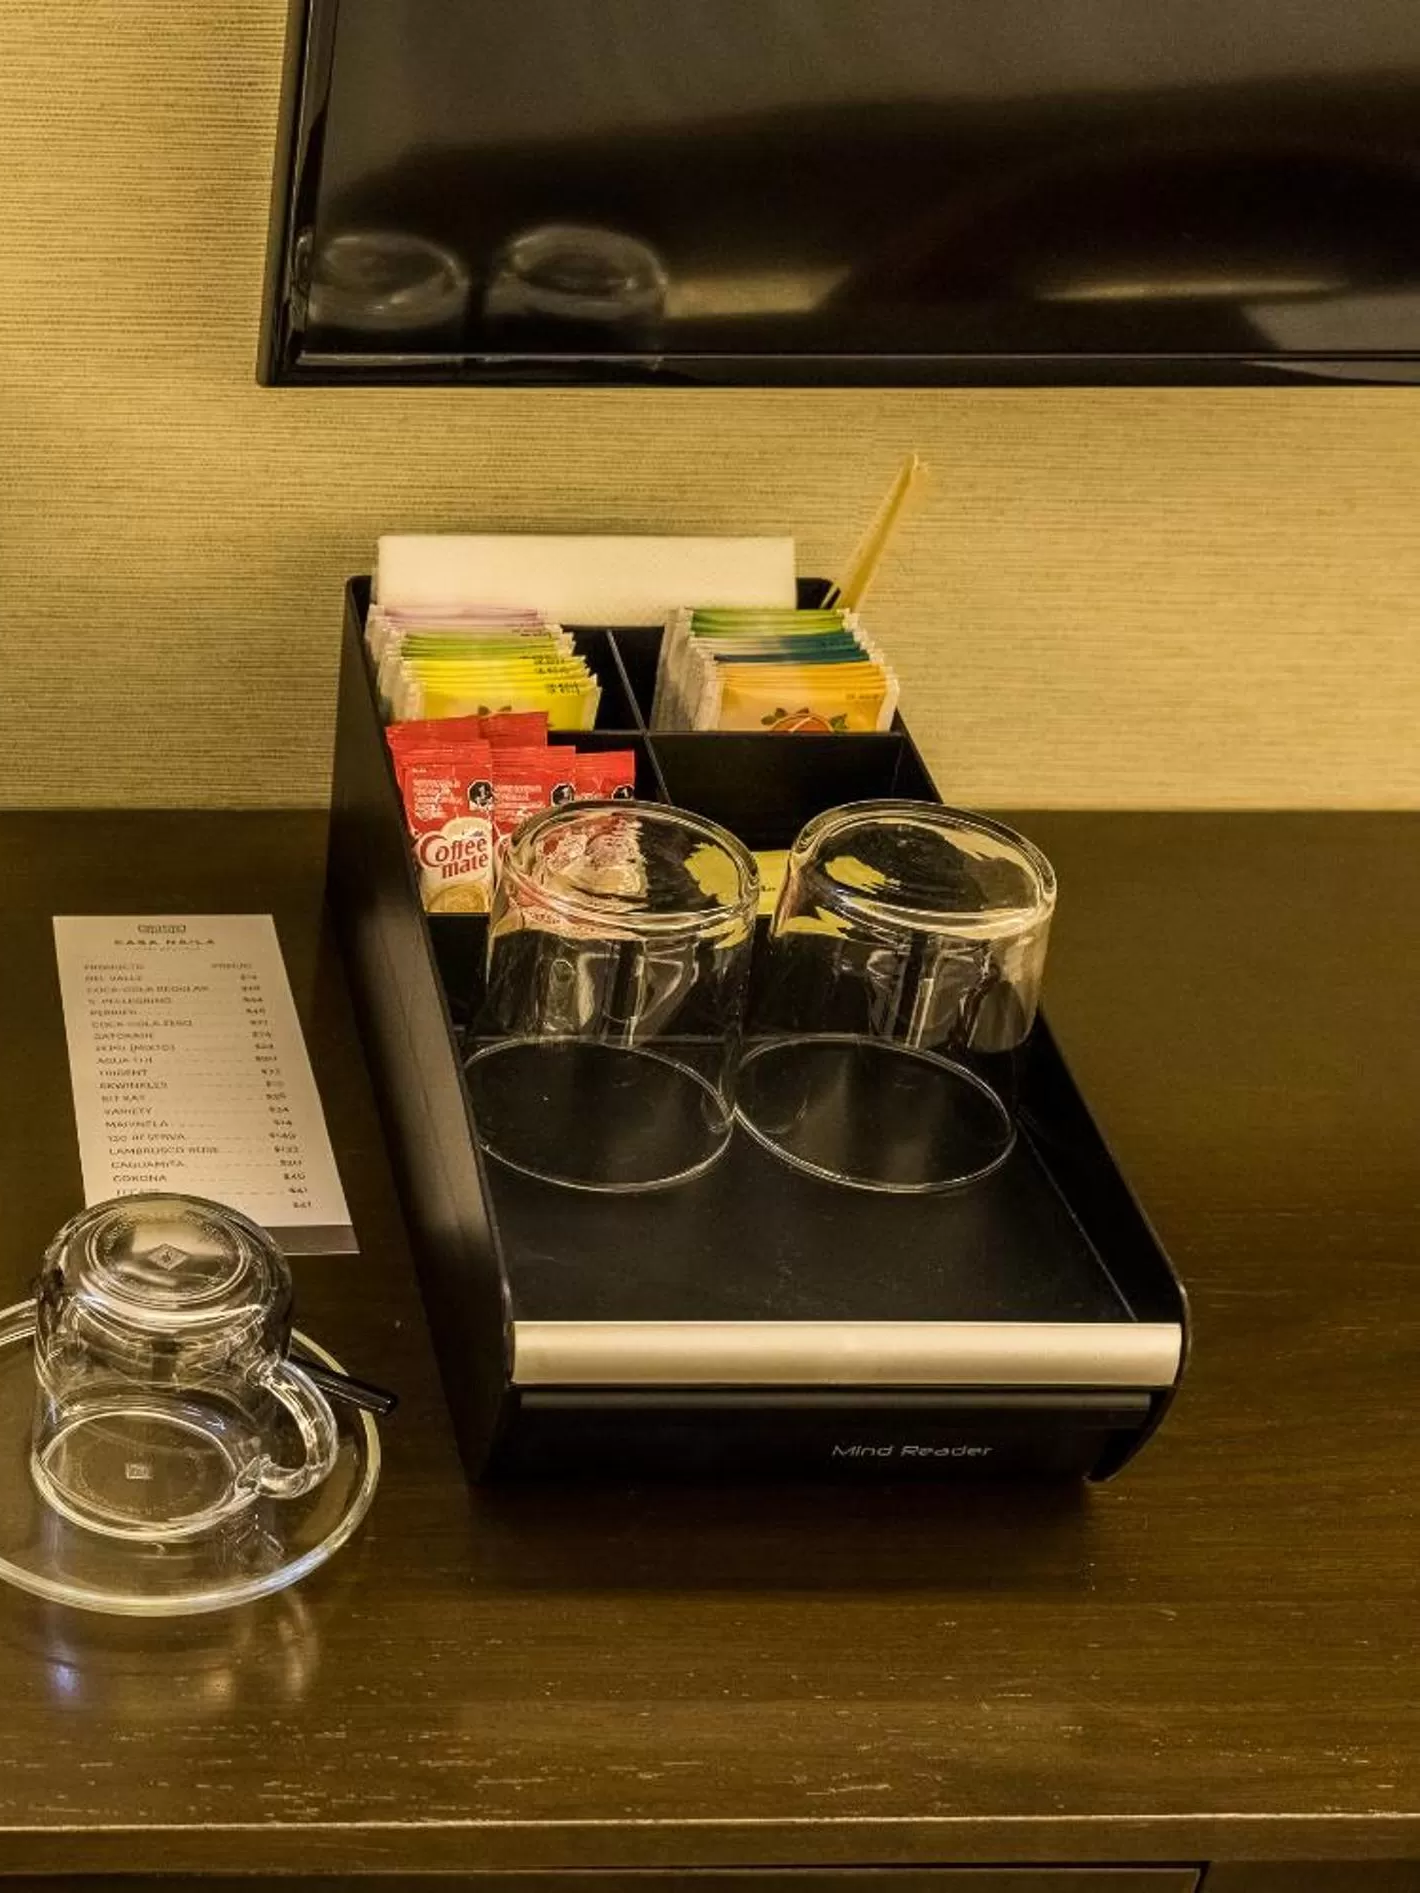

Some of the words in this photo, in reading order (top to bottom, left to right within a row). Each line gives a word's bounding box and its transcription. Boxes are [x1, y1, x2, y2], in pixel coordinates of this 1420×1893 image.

[418, 834, 488, 868] Coffee
[440, 852, 489, 879] mate
[832, 1445, 894, 1457] Mind
[900, 1445, 993, 1457] Reader
